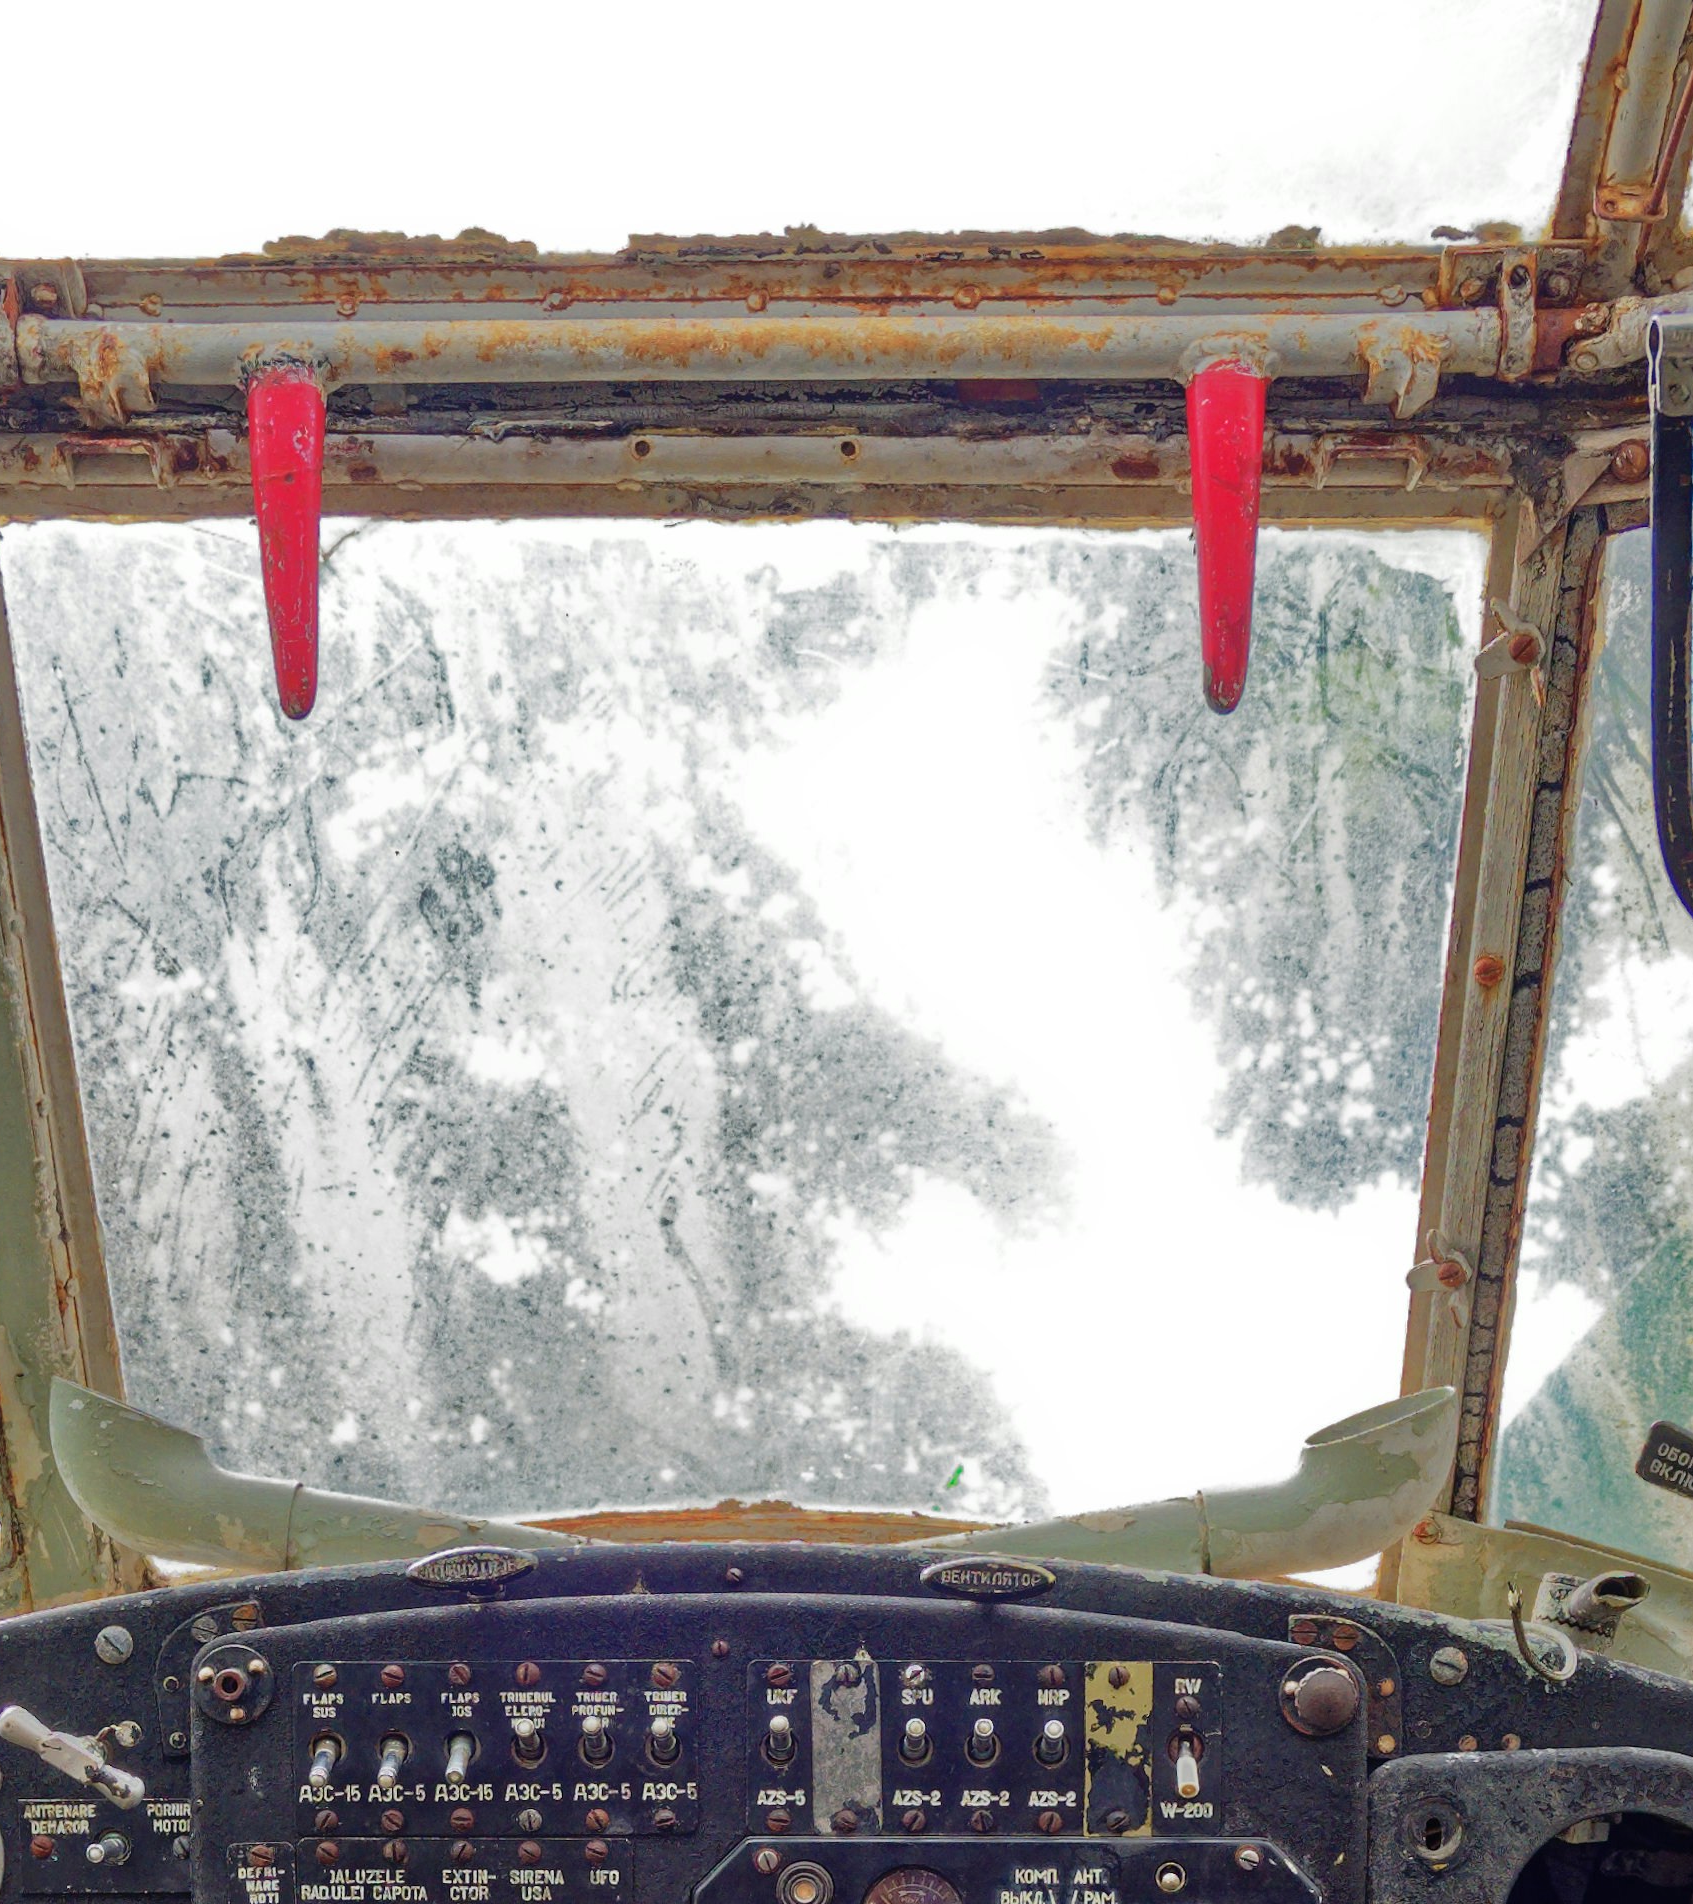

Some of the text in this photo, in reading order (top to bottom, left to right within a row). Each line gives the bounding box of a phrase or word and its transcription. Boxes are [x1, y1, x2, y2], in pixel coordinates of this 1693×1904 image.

[940, 1568, 1041, 1587] ВЕНТИЛЯТОР
[1175, 1679, 1202, 1694] RW
[303, 1694, 343, 1704] FLAPS
[371, 1694, 412, 1704] FLAPS
[441, 1693, 480, 1704] FLAPS
[766, 1689, 798, 1705] UKF
[901, 1689, 933, 1705] SPU
[969, 1689, 1001, 1705] ARK
[1037, 1689, 1070, 1705] MRP
[313, 1707, 336, 1719] SUS
[757, 1789, 806, 1807] AZS-5
[893, 1789, 941, 1806] AZS-2
[961, 1789, 1009, 1807] AZS-2
[1029, 1789, 1076, 1807] AZS-2
[23, 1804, 97, 1818] ANTRENARE
[1161, 1802, 1213, 1819] W-200
[31, 1820, 89, 1835] DEMAROR
[442, 1869, 496, 1885] EXTIN-
[510, 1870, 564, 1885] SIRENA
[590, 1870, 619, 1885] UFO
[1015, 1868, 1107, 1884] КОМП. АНТ.
[373, 1886, 428, 1901] CAPOTA
[450, 1885, 490, 1901] CTOR
[521, 1886, 552, 1901] USA
